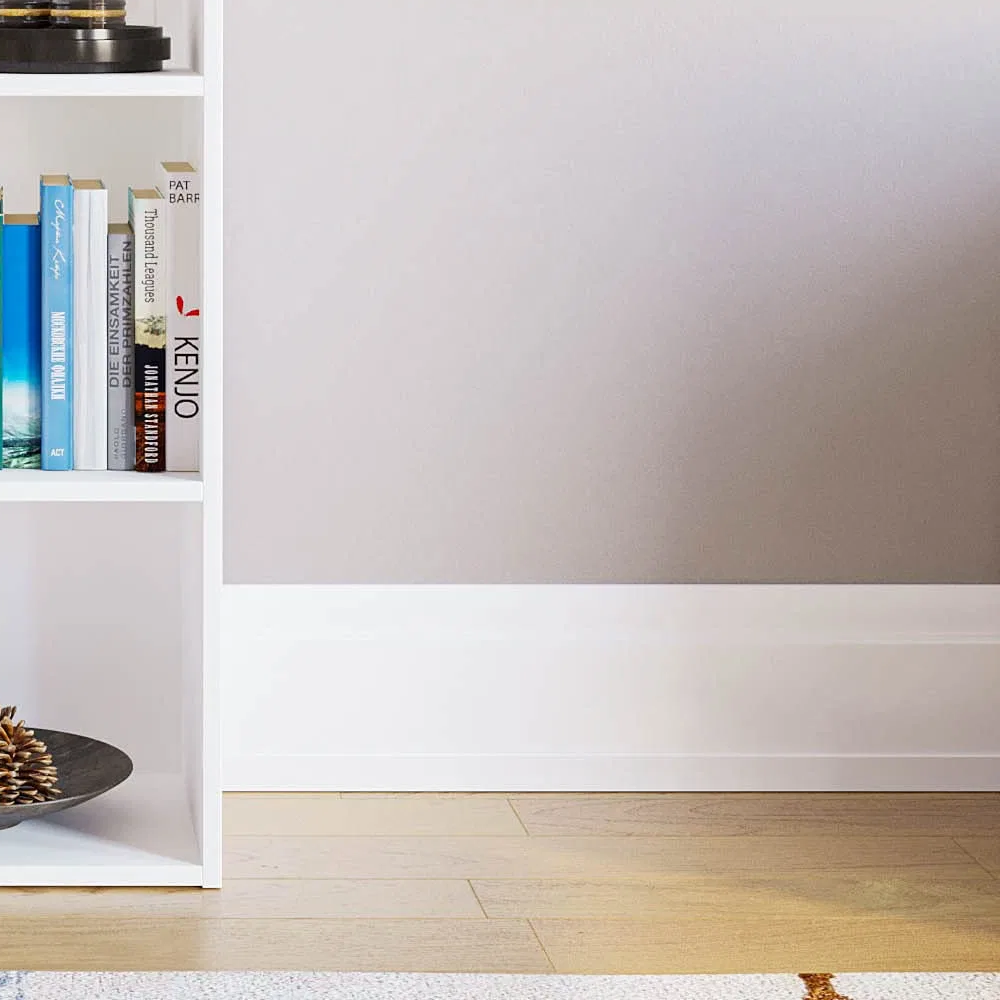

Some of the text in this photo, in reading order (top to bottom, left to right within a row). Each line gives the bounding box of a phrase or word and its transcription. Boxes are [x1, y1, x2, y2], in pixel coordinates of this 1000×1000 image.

[169, 180, 192, 190] PAT
[141, 208, 159, 304] Thousand Leagues
[50, 311, 66, 363] МОСКОВСКИЕ
[109, 255, 120, 388] DIE EINSAMKEIT
[122, 241, 132, 388] DER PRIMZAHLEN
[144, 364, 159, 464] JONATHAN STANDFORD
[174, 336, 199, 419] KENJO
